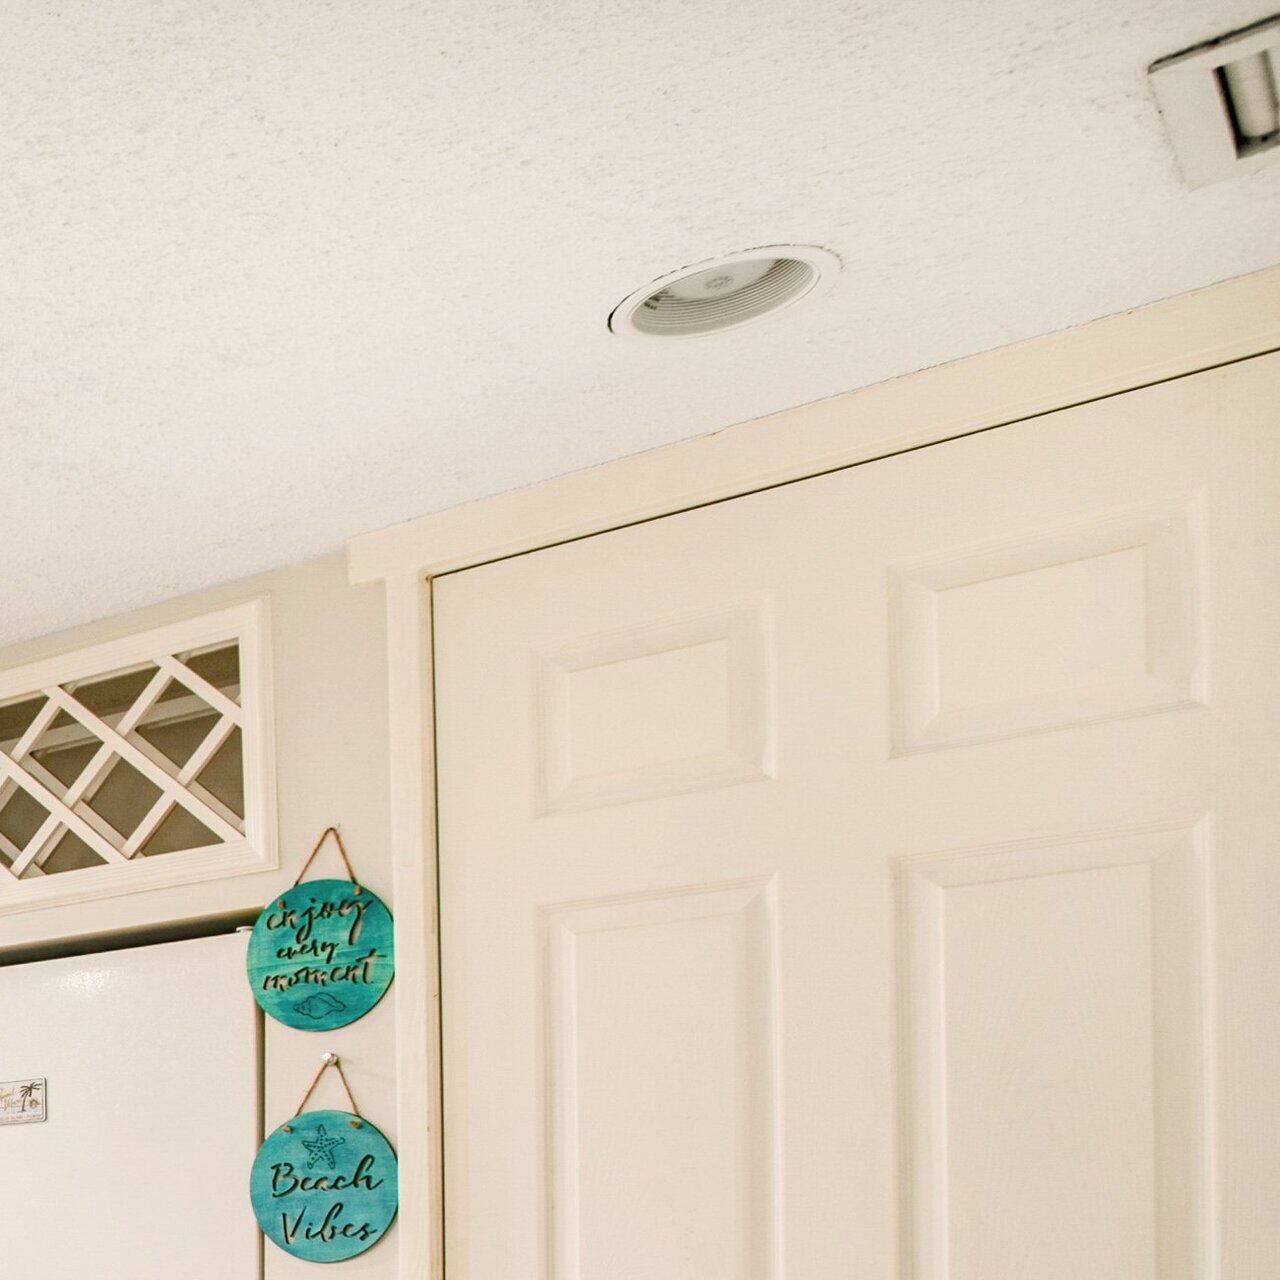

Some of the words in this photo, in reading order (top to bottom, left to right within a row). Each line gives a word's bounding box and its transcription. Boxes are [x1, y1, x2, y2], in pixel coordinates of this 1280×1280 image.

[266, 897, 374, 946] enjoy
[262, 948, 387, 992] moment
[276, 939, 340, 965] every
[270, 1153, 384, 1198] Beach
[281, 1202, 378, 1245] Vibes
